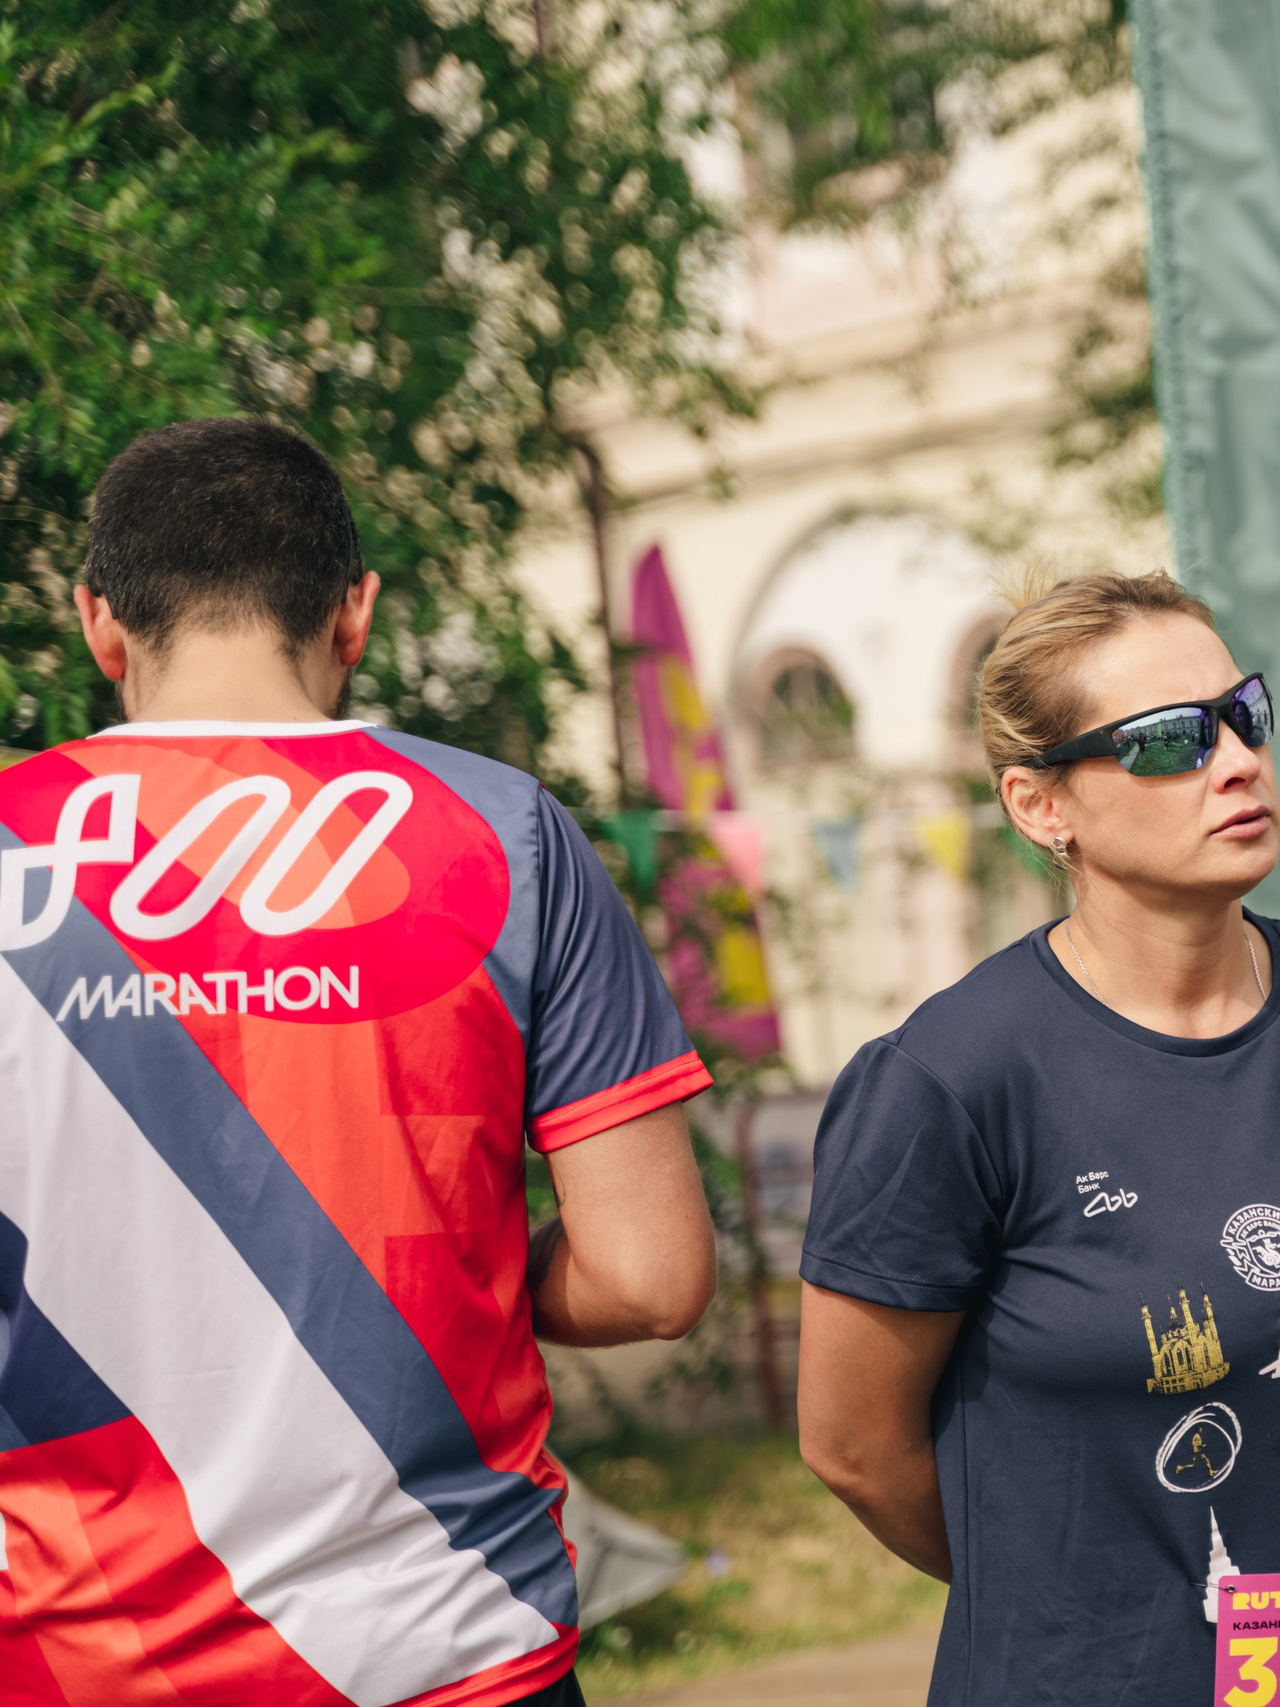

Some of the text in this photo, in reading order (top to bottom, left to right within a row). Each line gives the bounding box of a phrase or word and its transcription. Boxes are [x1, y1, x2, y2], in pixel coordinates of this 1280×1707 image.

[56, 966, 359, 1022] MARATHON
[1076, 1171, 1109, 1185] Ак Барс
[1077, 1182, 1101, 1194] Банк
